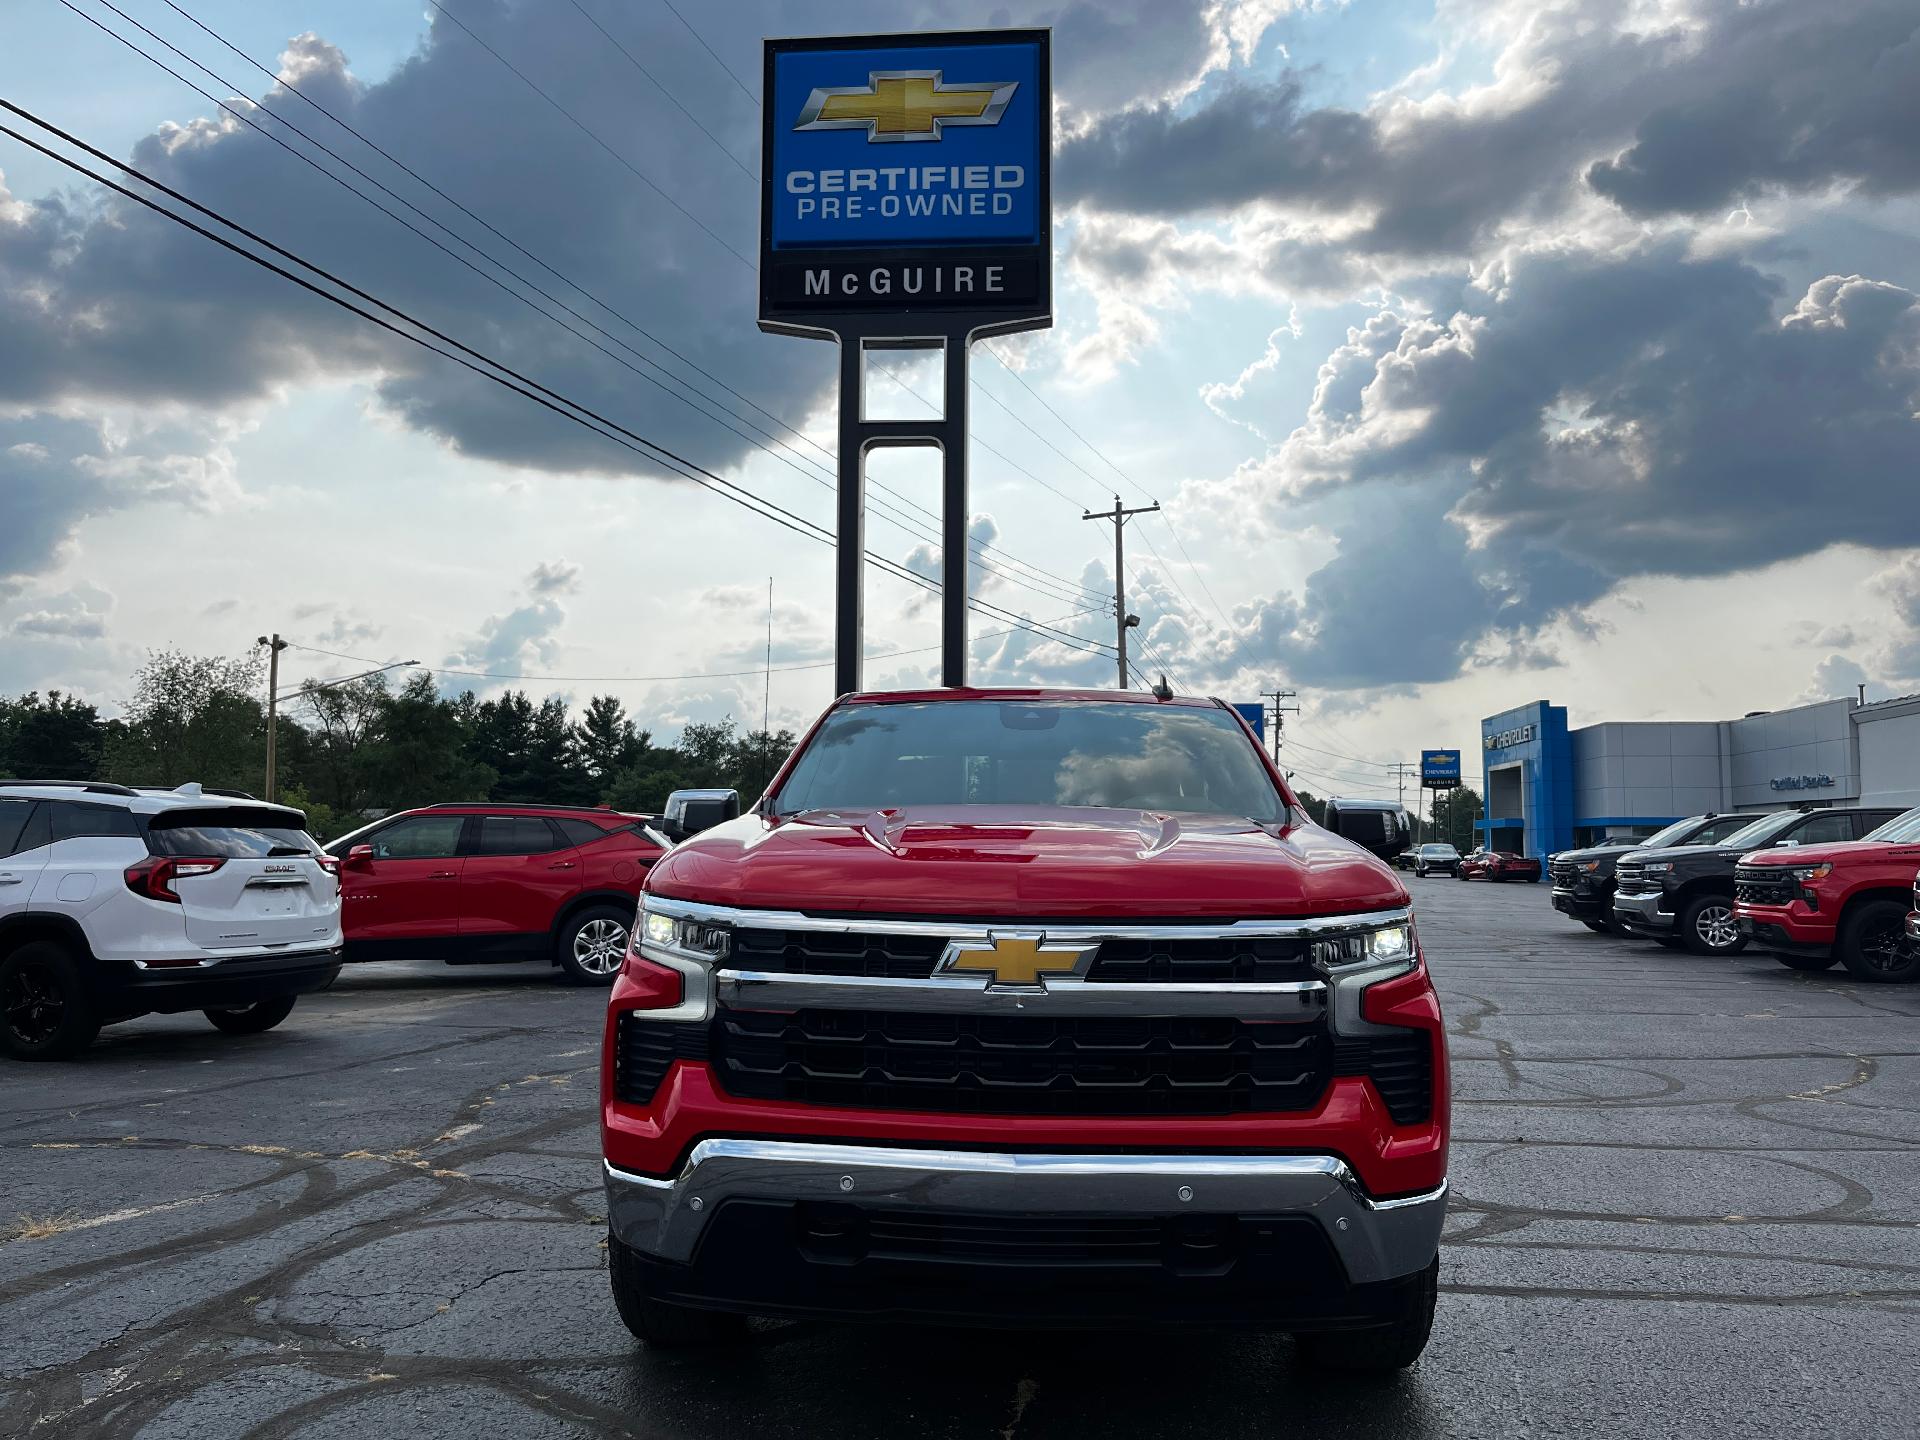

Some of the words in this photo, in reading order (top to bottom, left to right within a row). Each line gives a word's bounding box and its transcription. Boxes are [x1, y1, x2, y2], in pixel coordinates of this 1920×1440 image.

[786, 165, 1025, 194] CERTIFIED
[797, 193, 1013, 220] PRE-OWNED
[804, 266, 1005, 295] McGUIRE
